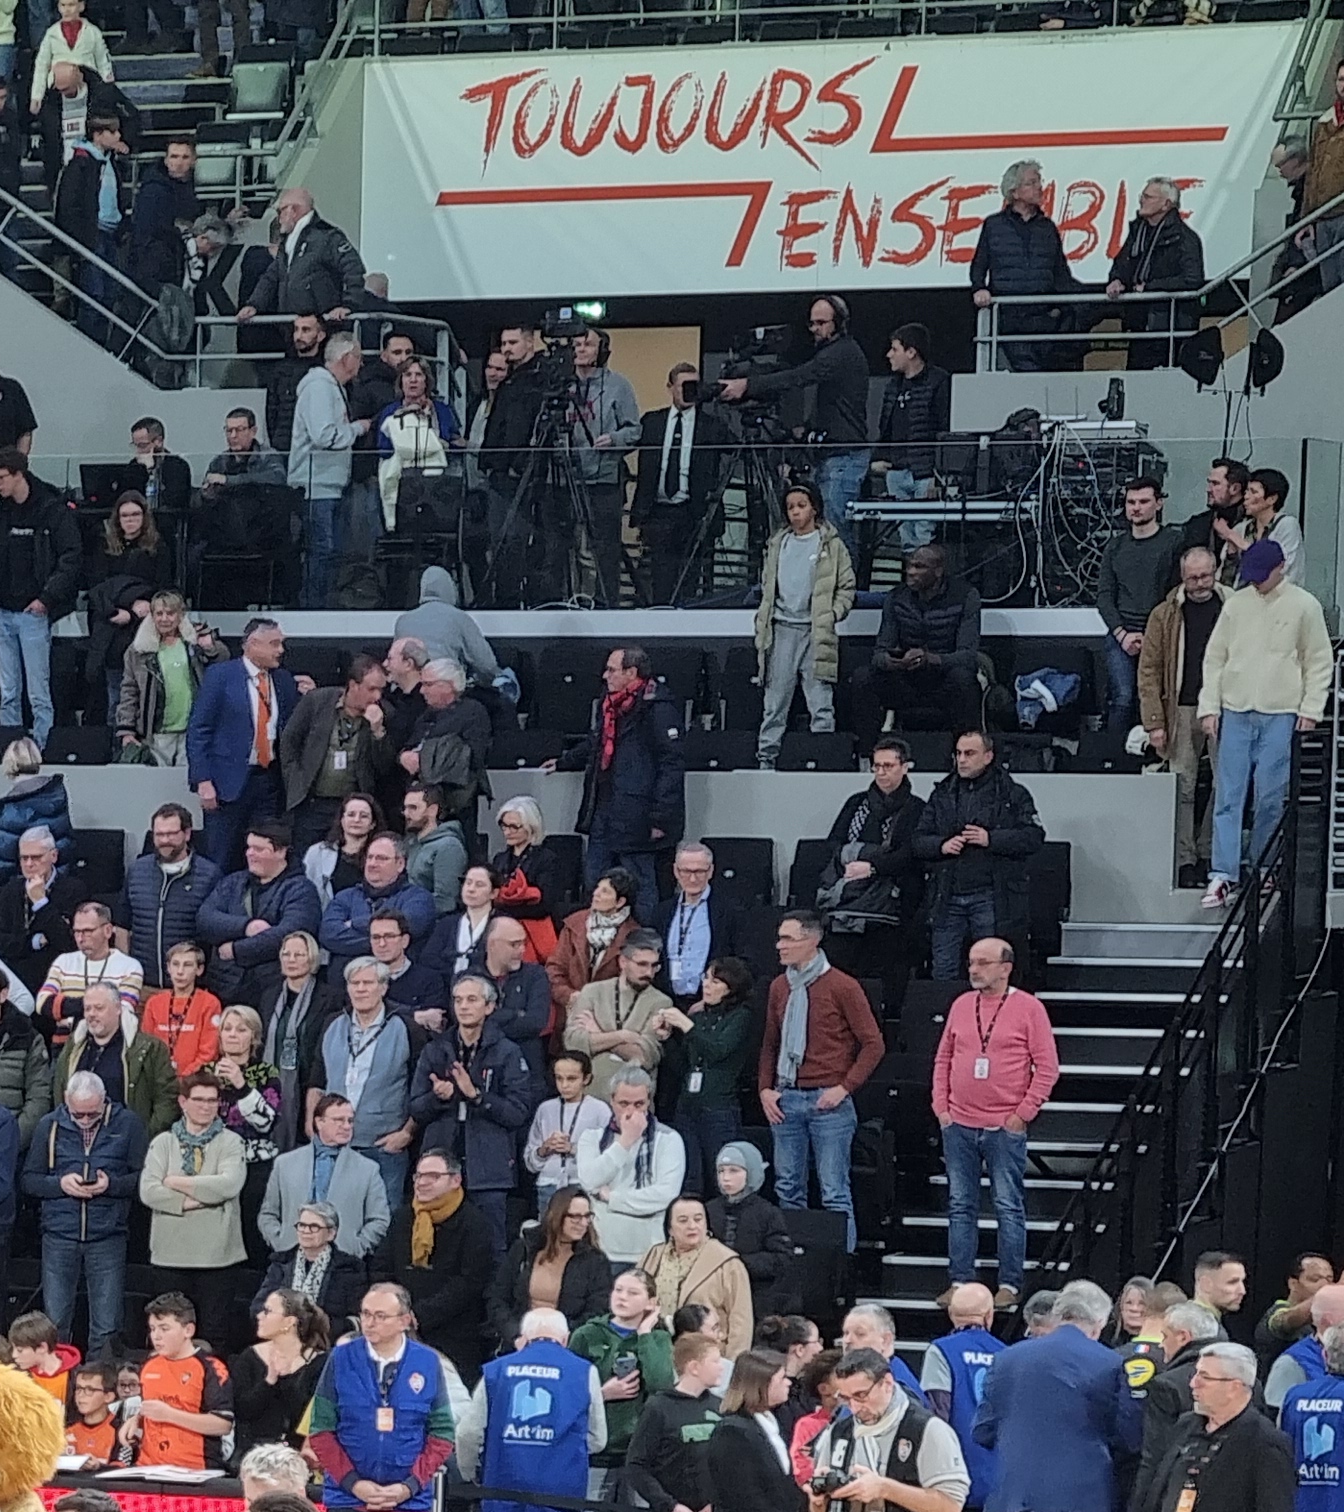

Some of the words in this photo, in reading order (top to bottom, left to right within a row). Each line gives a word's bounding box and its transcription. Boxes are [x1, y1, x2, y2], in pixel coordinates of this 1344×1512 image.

[460, 55, 882, 176] TOUJOURS
[777, 177, 1205, 271] ENSEBL
[507, 1364, 561, 1380] PLACEUR
[1297, 1399, 1344, 1412] PLACEUR
